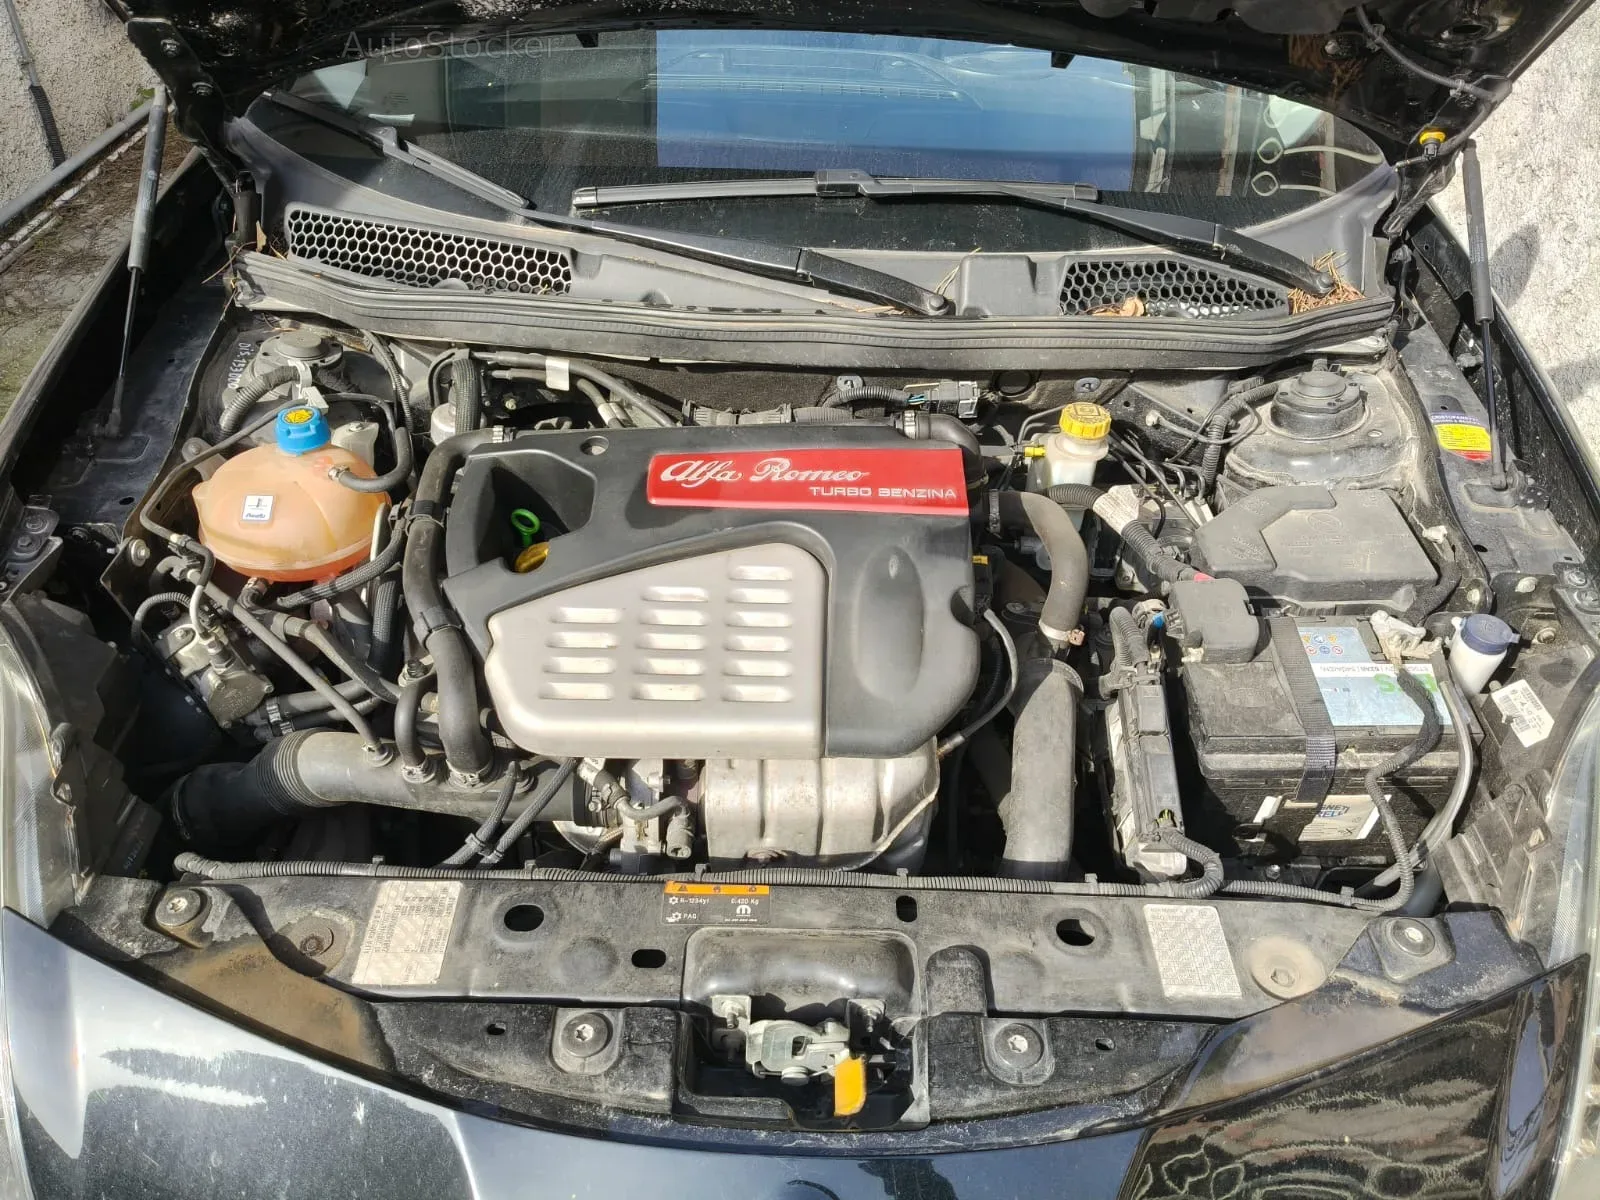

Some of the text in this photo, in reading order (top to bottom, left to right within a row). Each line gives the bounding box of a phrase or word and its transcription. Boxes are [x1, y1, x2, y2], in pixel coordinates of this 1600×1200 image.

[660, 457, 870, 488] Alfa Romeo
[809, 486, 957, 499] TURBO BENZINA
